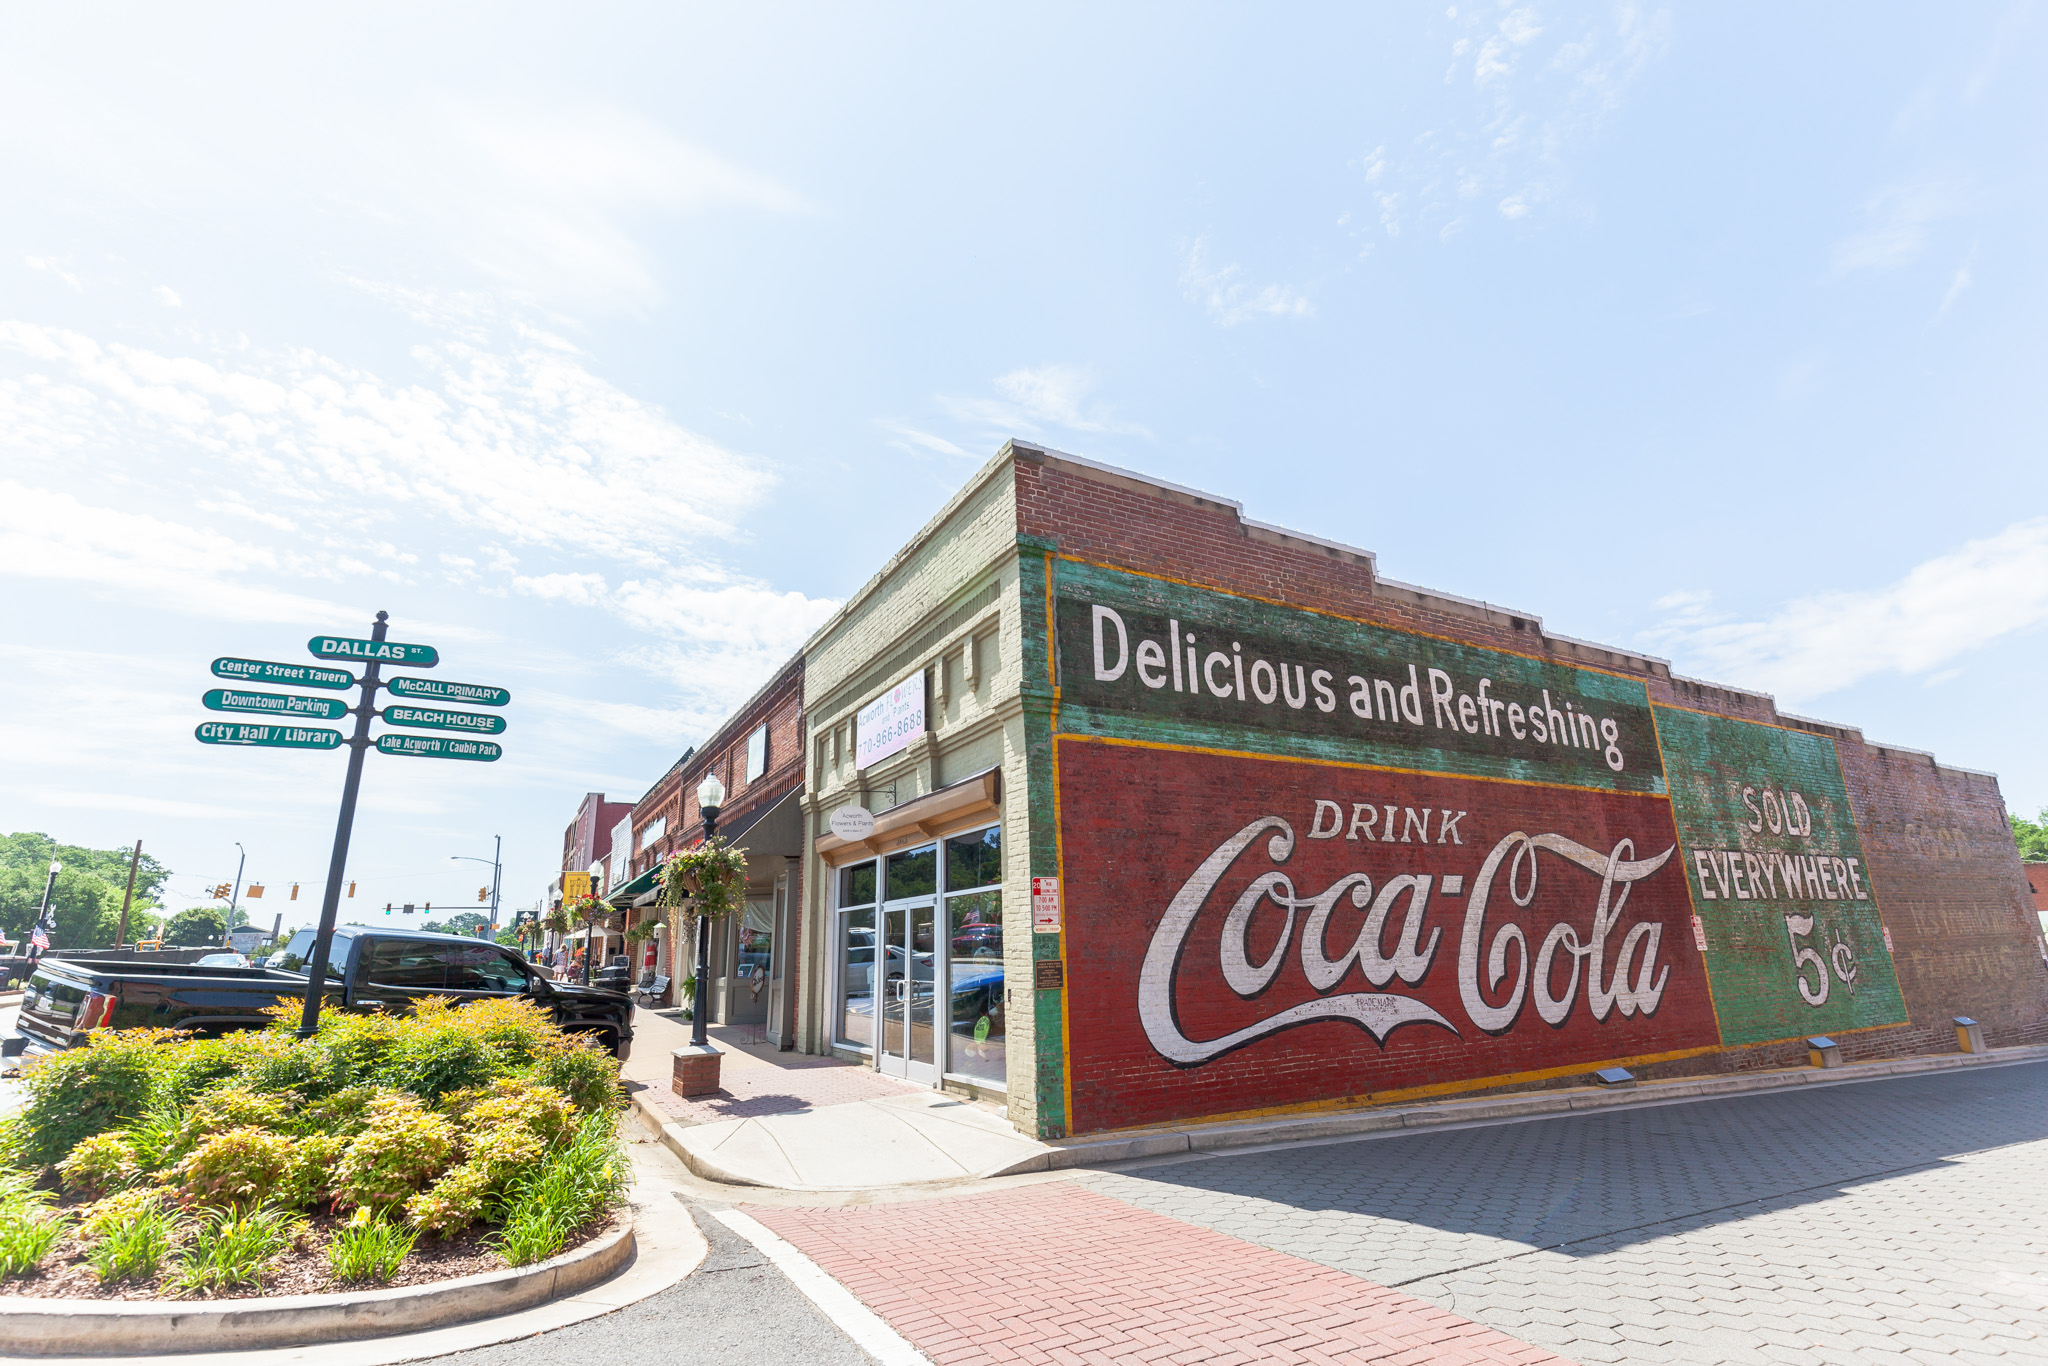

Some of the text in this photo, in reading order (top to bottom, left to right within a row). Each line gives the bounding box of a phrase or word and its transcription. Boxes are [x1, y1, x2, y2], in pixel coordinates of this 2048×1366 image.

[321, 639, 405, 660] DALLAS
[219, 659, 348, 684] Center Street Tavern
[398, 679, 500, 700] McCALL PRIMARY
[1091, 604, 1624, 771] Delicious and Refreshing
[221, 691, 330, 716] Downtown Parking
[858, 701, 884, 727] Acworth
[393, 709, 495, 728] BEACH HOUSE
[201, 723, 337, 745] City Hall / Library
[381, 735, 497, 756] Lake Acworth / Cauble Park
[858, 709, 922, 758] 770-966-8688
[1307, 800, 1467, 845] DRINK
[1742, 786, 1811, 838] SOLD
[1692, 849, 1868, 900] EVERYWHERE
[1138, 816, 1676, 1066] Coca-Cola
